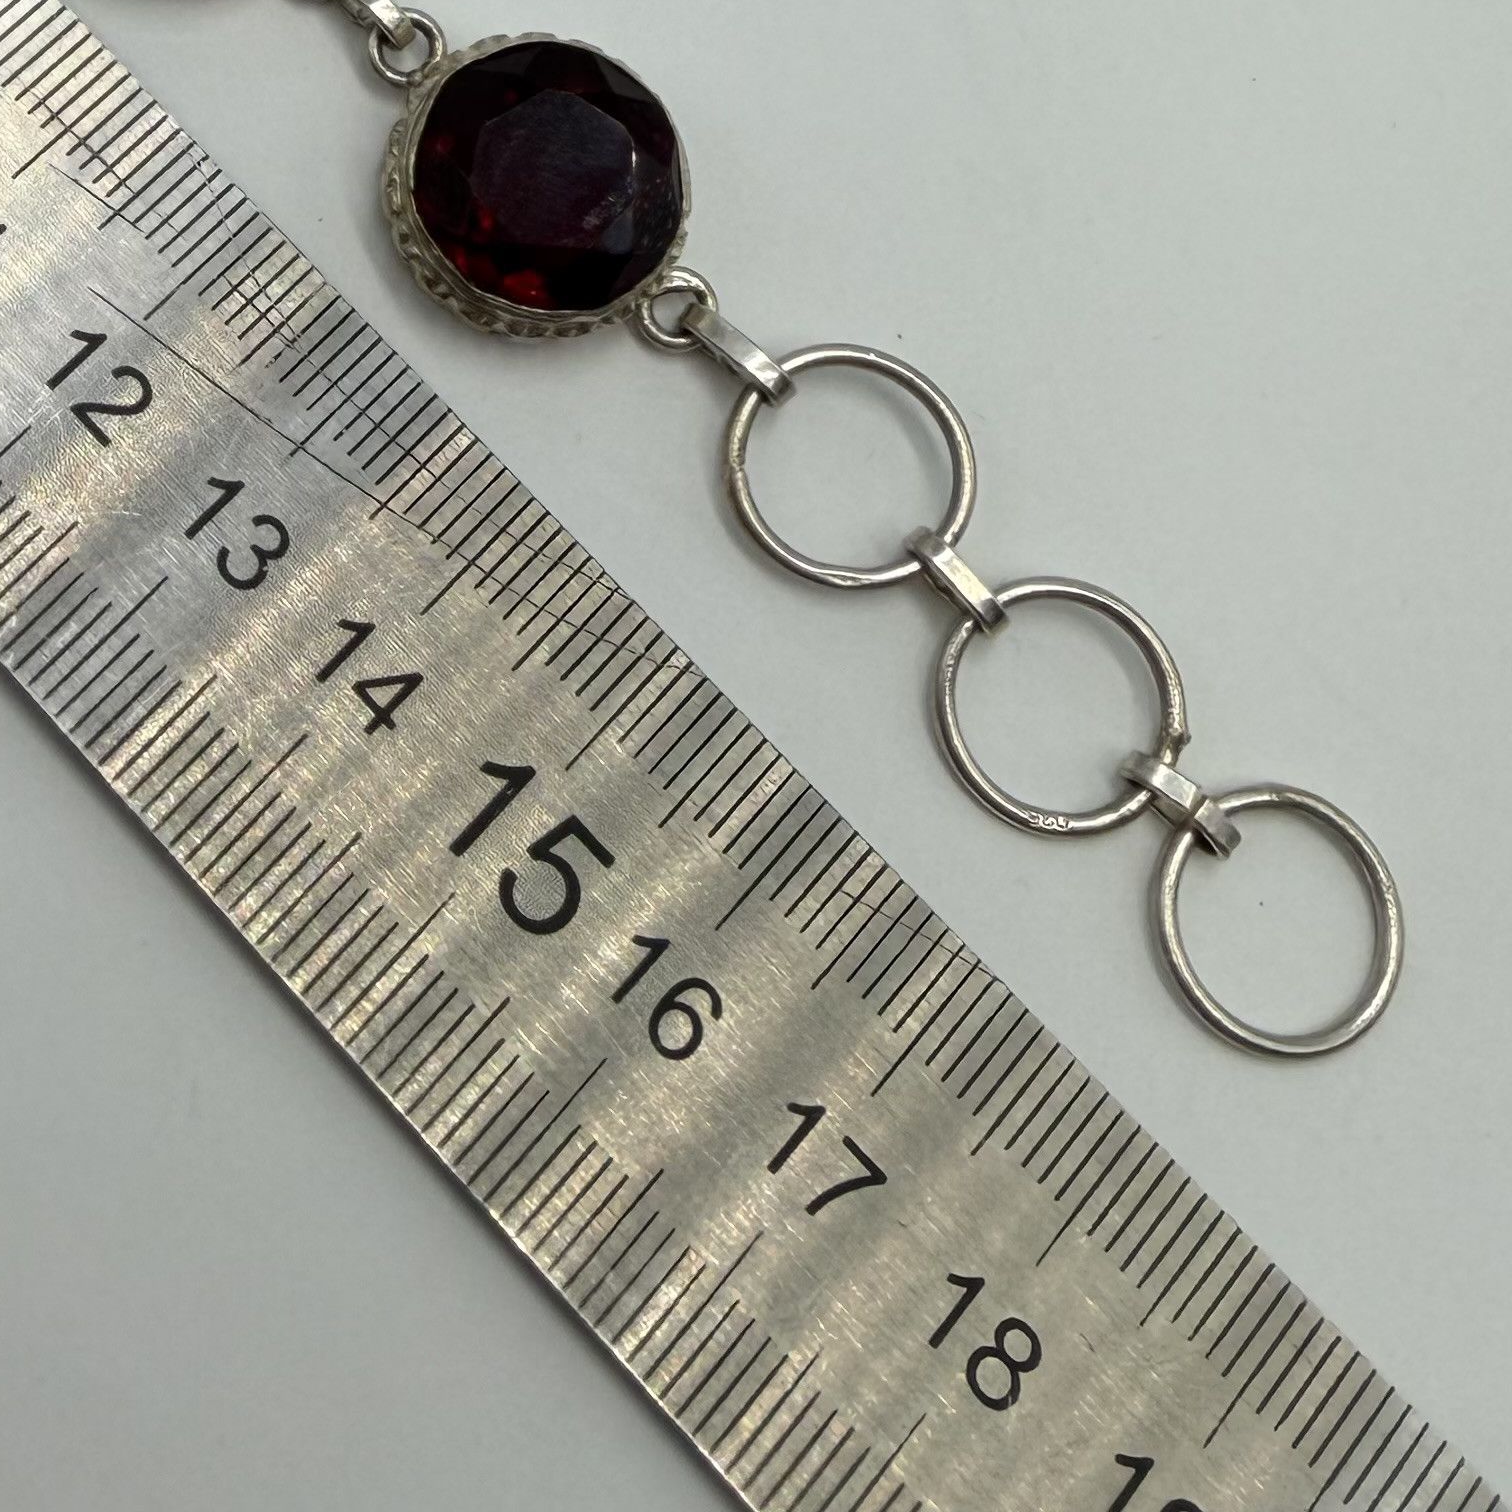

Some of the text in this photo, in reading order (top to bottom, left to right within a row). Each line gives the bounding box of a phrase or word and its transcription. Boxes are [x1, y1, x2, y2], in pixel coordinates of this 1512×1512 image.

[46, 330, 153, 447] 12
[184, 477, 290, 591] 13
[315, 619, 424, 735] 14
[449, 760, 615, 935] 15
[611, 935, 722, 1060] 16
[767, 1103, 887, 1216] 17
[929, 1273, 1042, 1411] 18
[1107, 1454, 1202, 1512] 1
